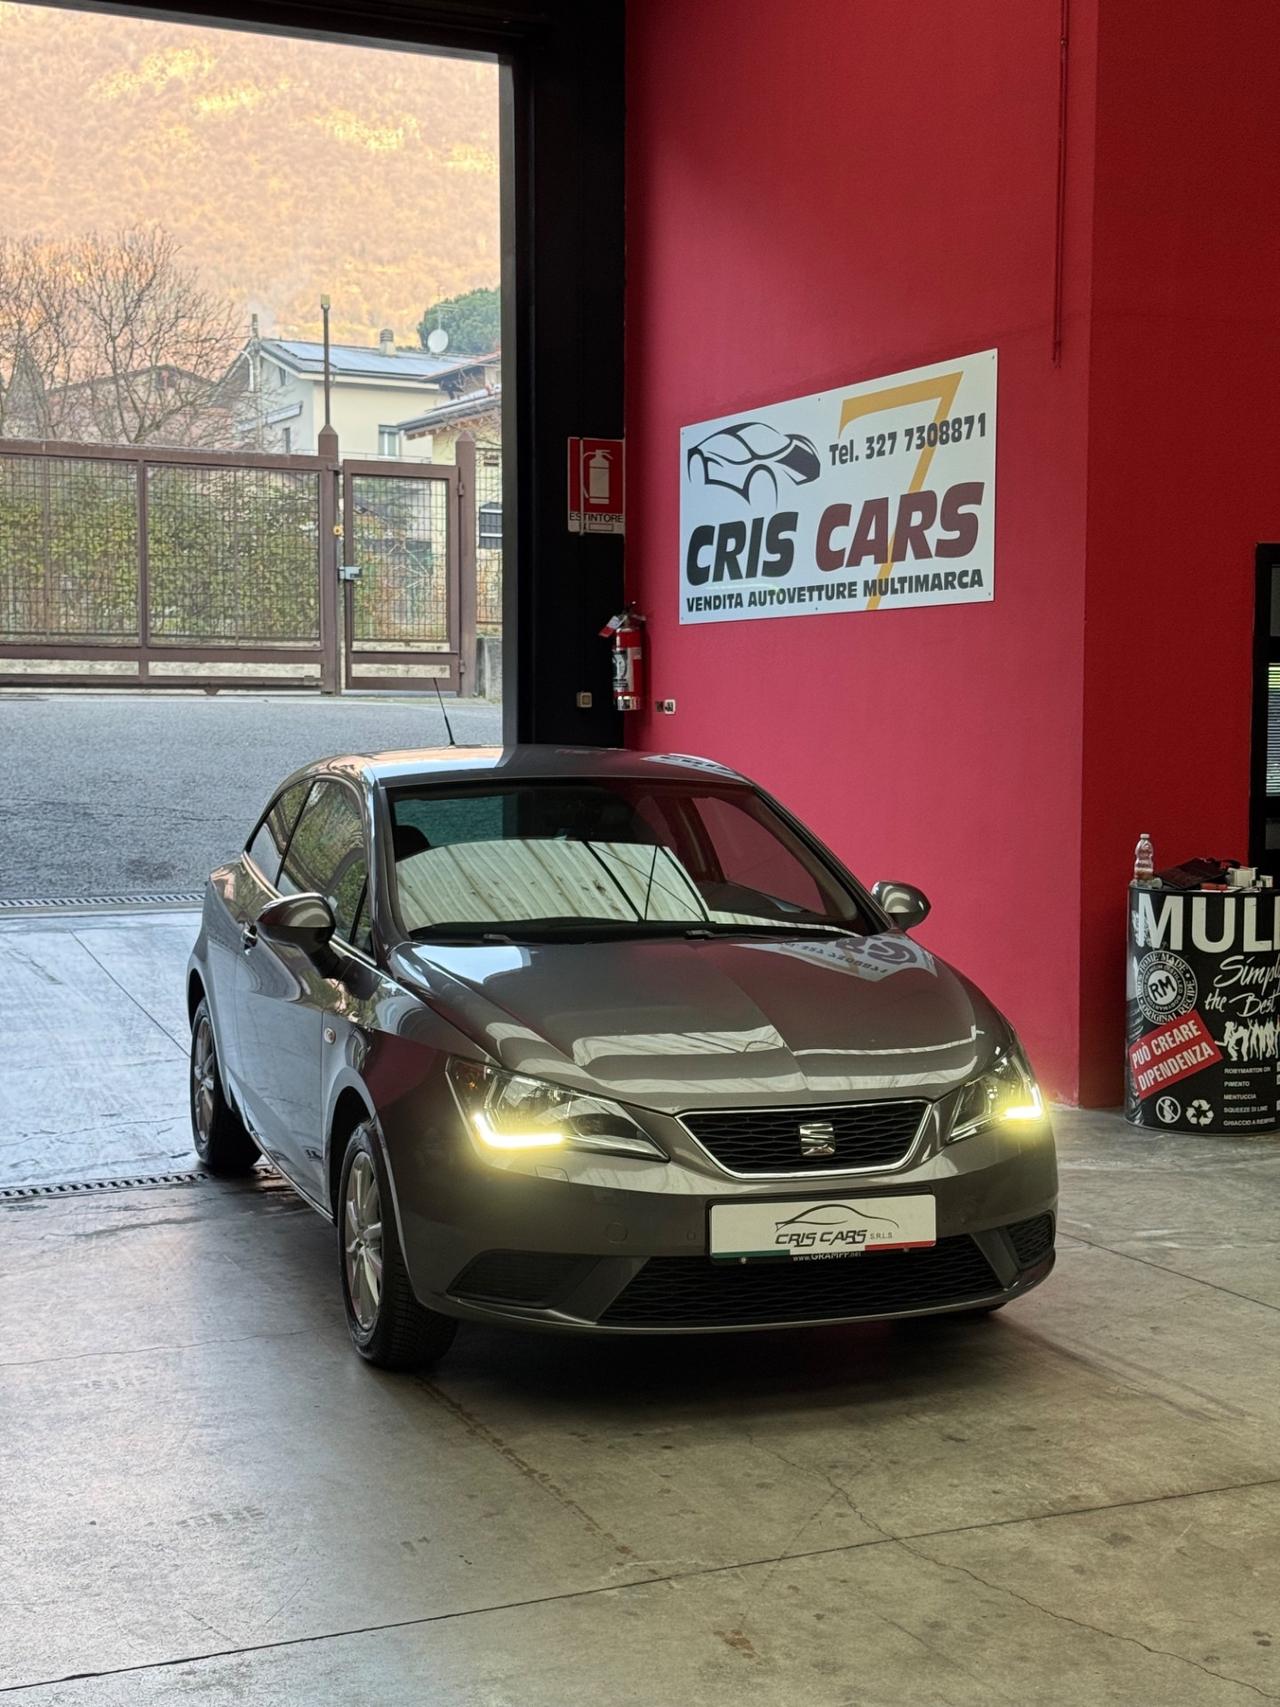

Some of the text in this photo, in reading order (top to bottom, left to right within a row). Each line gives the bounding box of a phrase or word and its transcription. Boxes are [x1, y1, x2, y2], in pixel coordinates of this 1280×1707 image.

[829, 412, 986, 466] Tel. 327 7308871
[569, 512, 625, 523] ESTINTORE
[686, 481, 985, 586] CRIS CARS
[686, 569, 984, 612] VENDITA AUTOVETTURE MULTIMARCA
[1138, 893, 1280, 953] MUL
[1160, 953, 1186, 974] MADE
[1141, 1004, 1177, 1022] ORIGINAL
[1177, 980, 1195, 1015] RECIPE
[1149, 975, 1176, 1001] RM
[1204, 988, 1227, 1013] the
[1229, 989, 1280, 1017] Best
[1132, 1020, 1201, 1069] PUÒ CREARE
[1138, 1041, 1215, 1091] DIPENDENZA
[775, 1232, 817, 1248] CRIS
[819, 1229, 868, 1246] CARS
